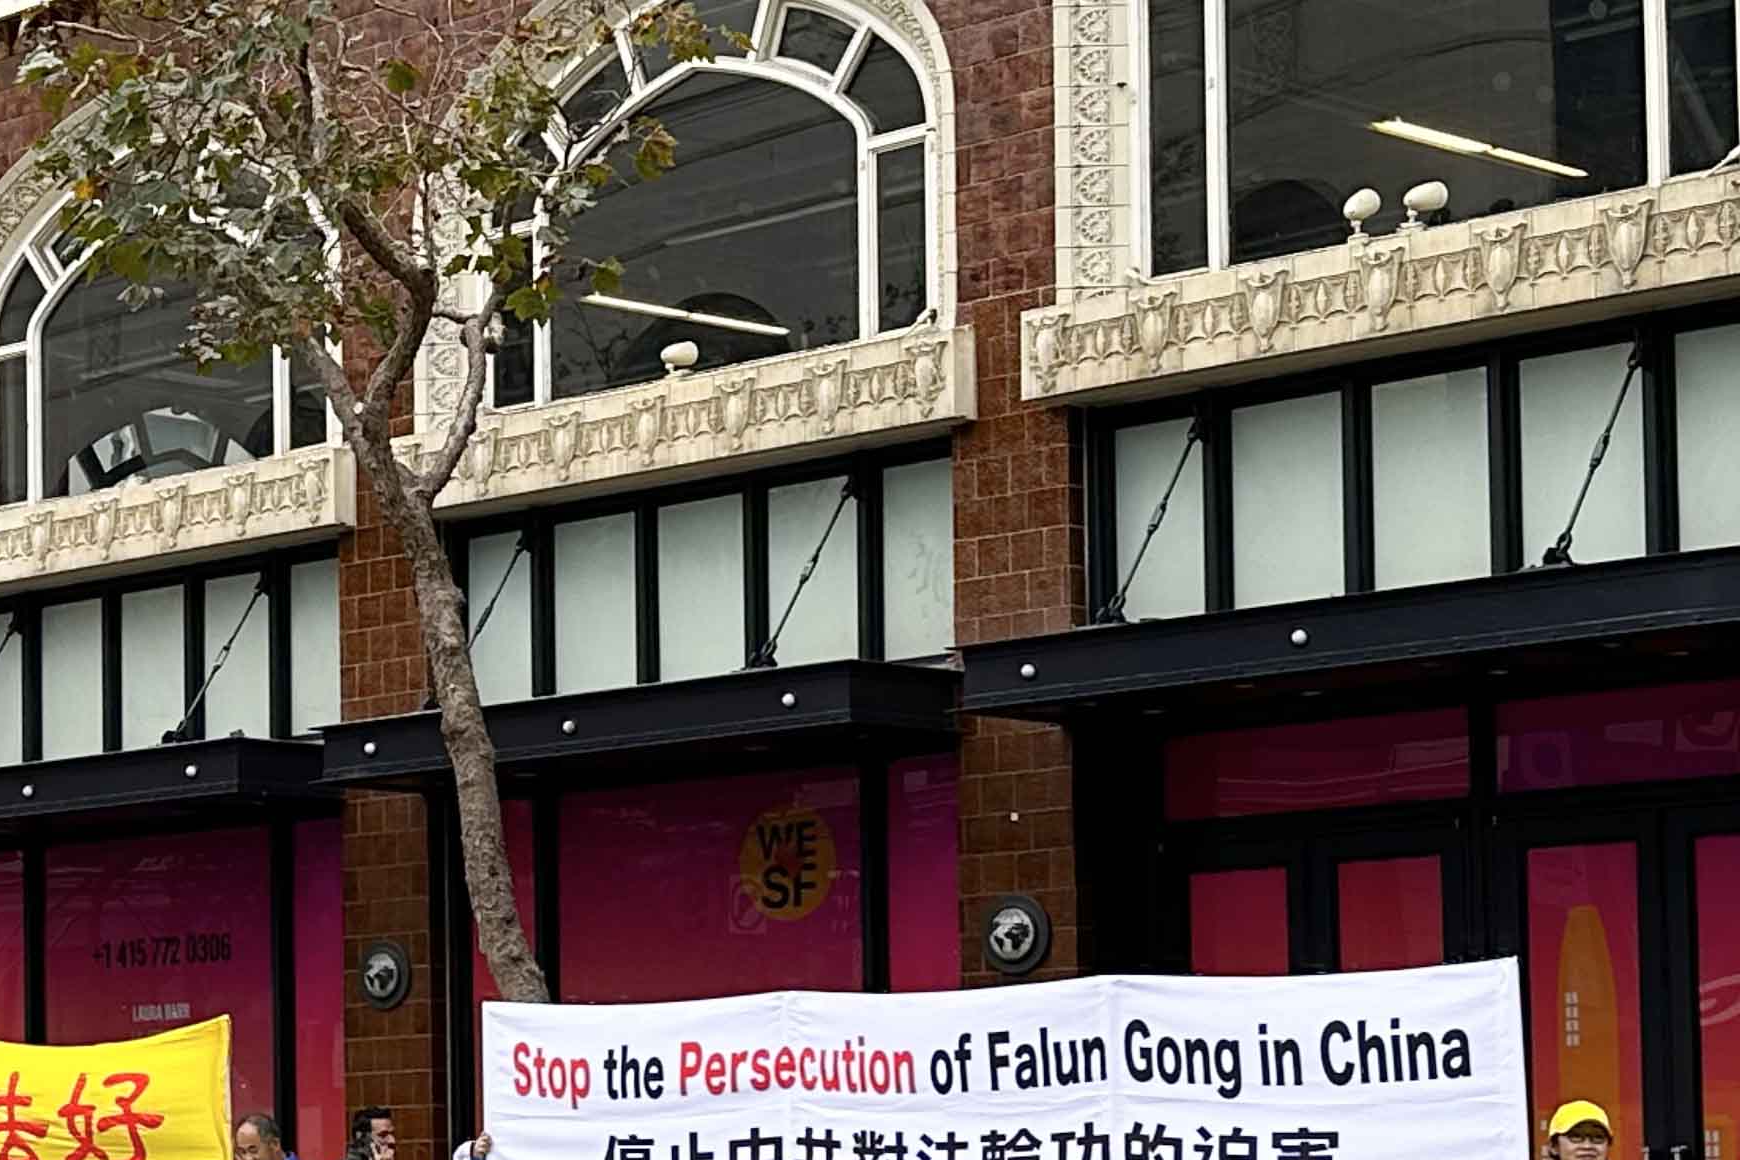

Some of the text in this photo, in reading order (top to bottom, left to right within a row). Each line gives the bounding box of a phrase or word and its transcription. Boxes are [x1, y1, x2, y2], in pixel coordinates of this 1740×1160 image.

[755, 820, 817, 860] WE
[761, 862, 817, 909] SF
[116, 938, 147, 969] 415
[151, 936, 181, 965] 772
[512, 1017, 1472, 1109] Stop the Persecution of Falun Gong in China
